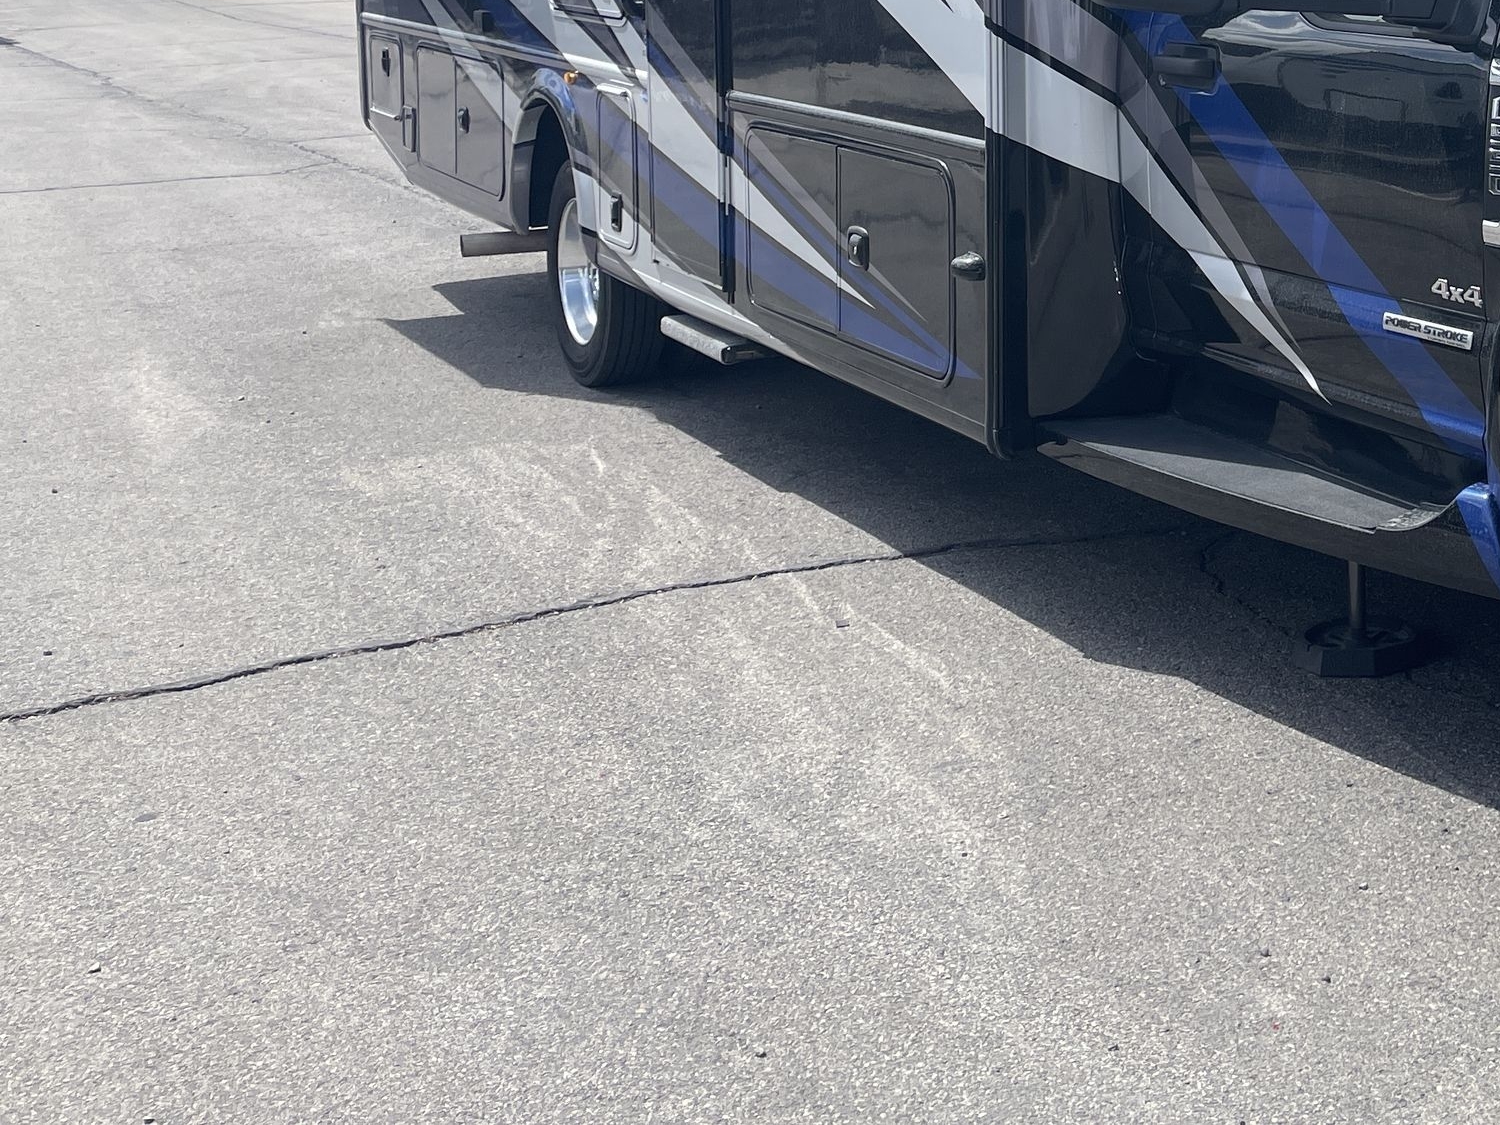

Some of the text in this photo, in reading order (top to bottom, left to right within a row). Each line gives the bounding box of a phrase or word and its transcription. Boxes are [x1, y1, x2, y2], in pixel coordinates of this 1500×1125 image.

[1431, 278, 1484, 308] 4x4
[1385, 316, 1422, 334] POWER
[1423, 324, 1469, 344] STROKE
